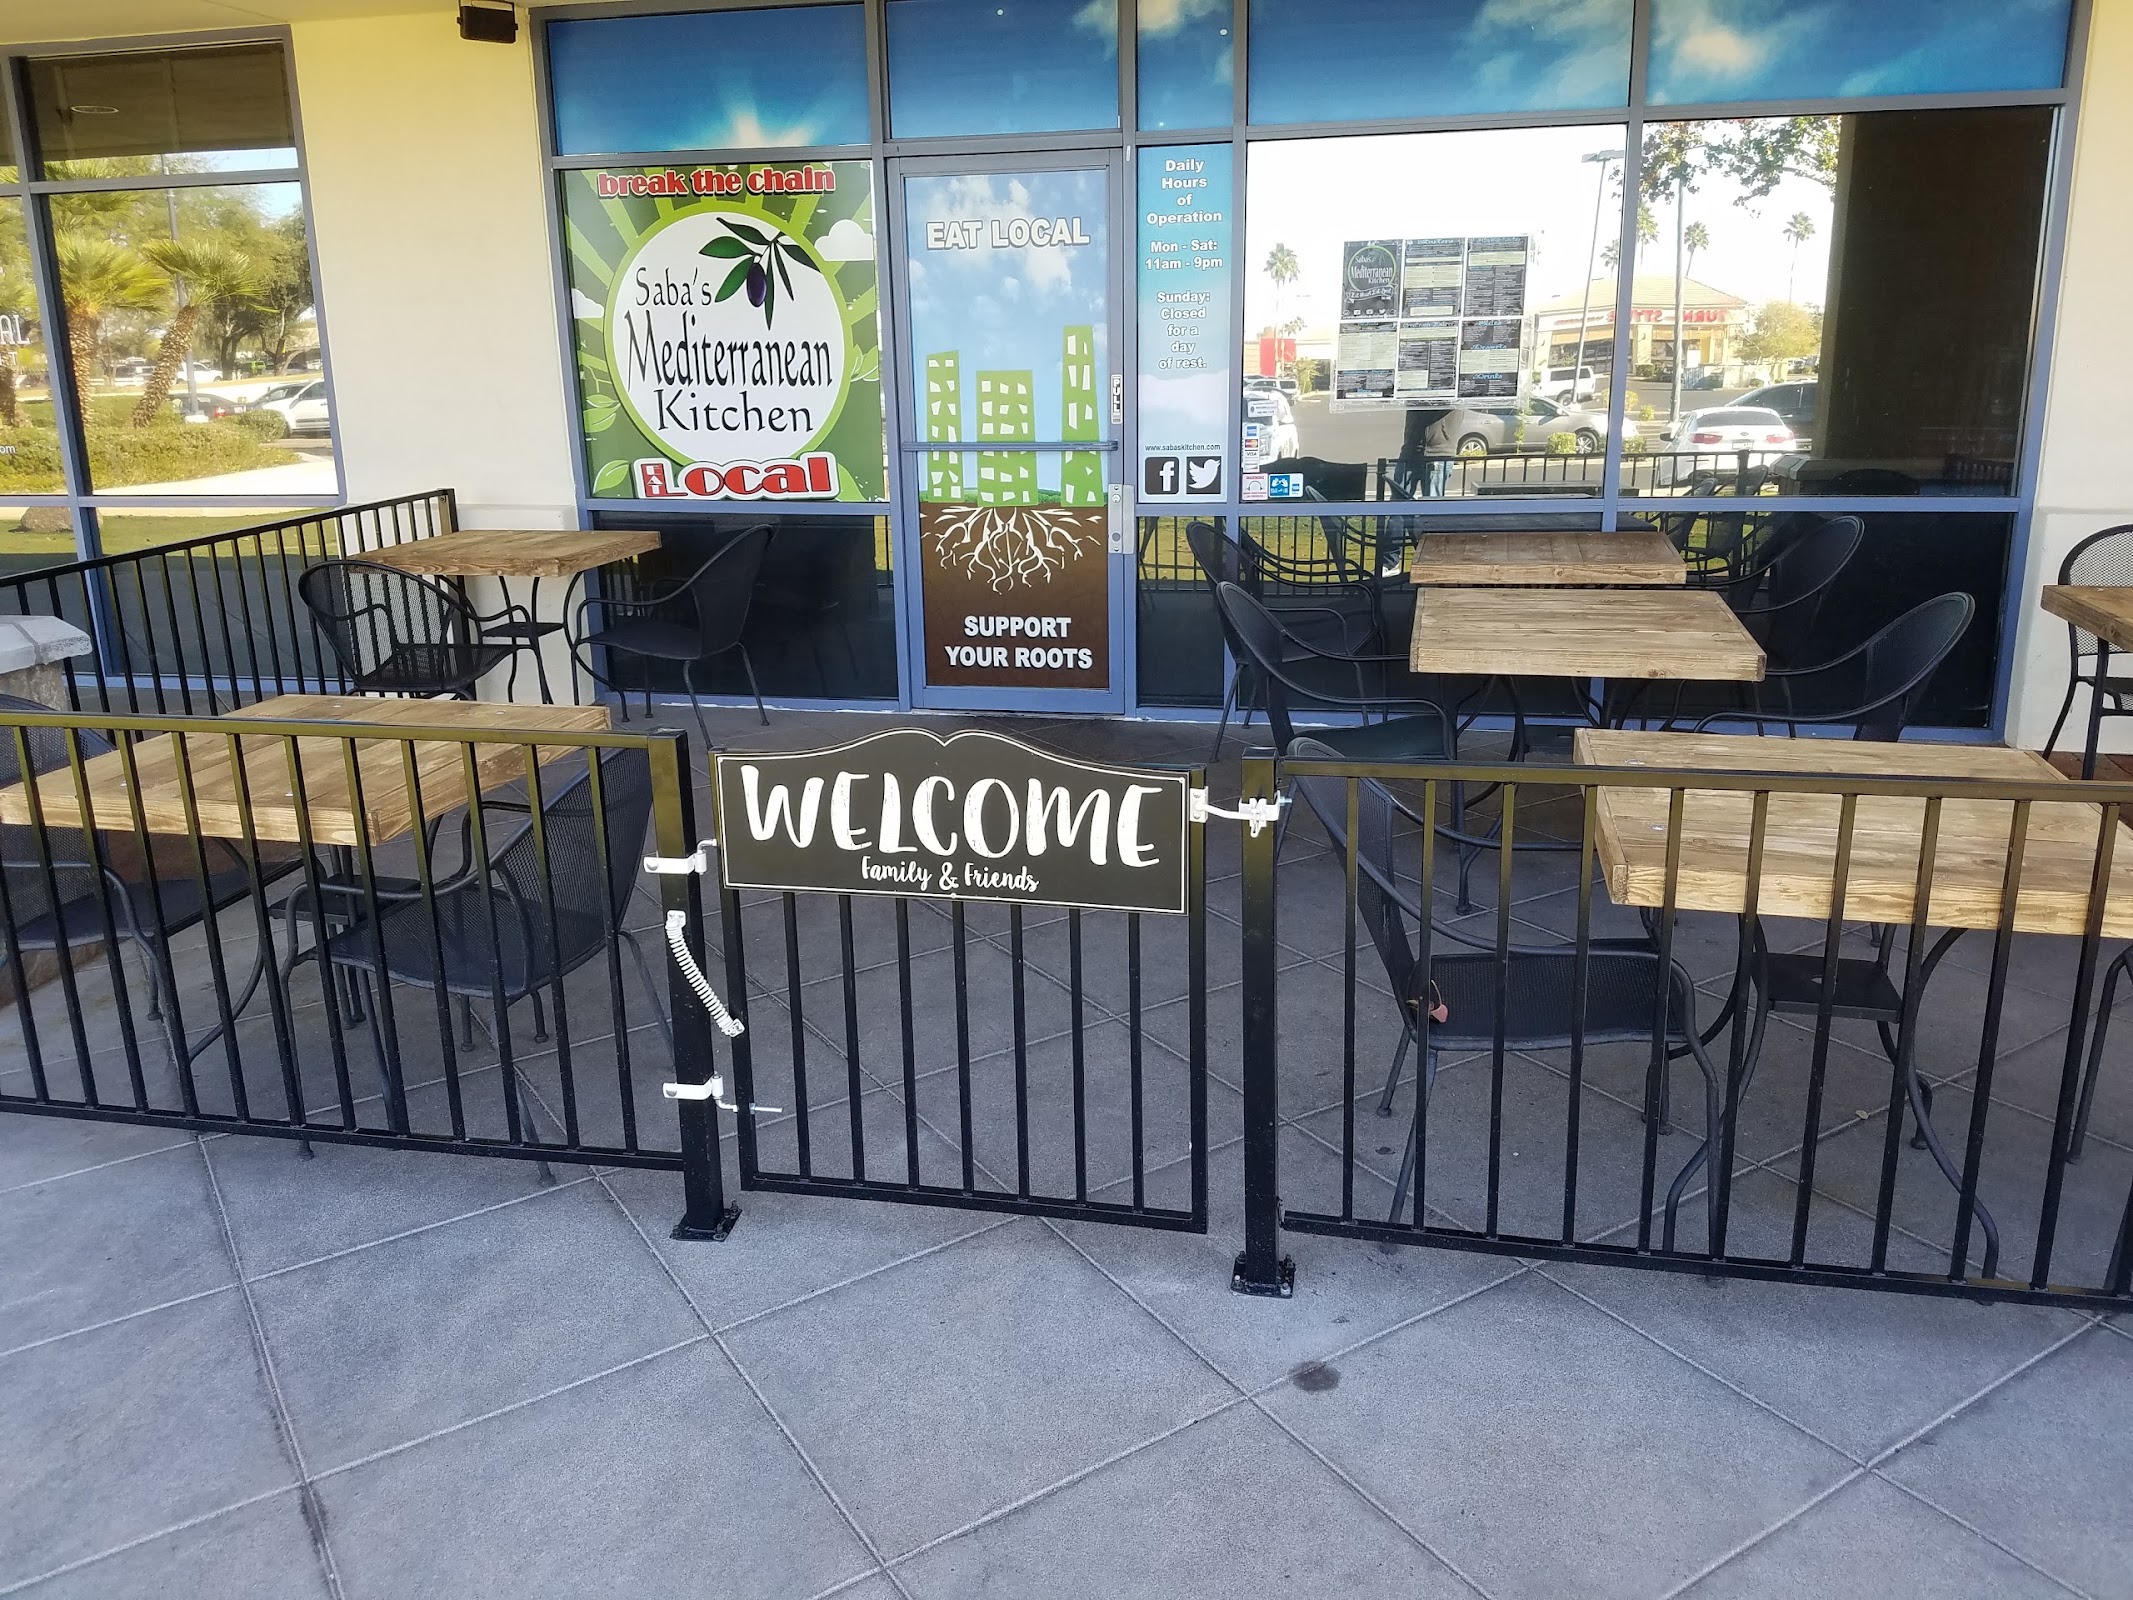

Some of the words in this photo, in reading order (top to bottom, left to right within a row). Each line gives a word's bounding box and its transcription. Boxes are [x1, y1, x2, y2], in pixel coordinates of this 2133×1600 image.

[1165, 159, 1205, 173] Daily
[599, 170, 688, 197] break
[692, 169, 741, 195] the
[747, 166, 836, 192] chain
[1161, 177, 1208, 190] Hours
[1176, 194, 1193, 206] of
[1146, 211, 1222, 227] Operation
[926, 220, 983, 250] EAT
[991, 217, 1091, 248] LOCAL
[1150, 241, 1179, 253] Mon
[1190, 239, 1218, 251] Sat:
[1145, 258, 1182, 270] 11am
[1193, 257, 1224, 271] 9pm
[635, 267, 712, 307] Saba's
[1157, 291, 1210, 305] Sunday:
[1161, 307, 1206, 320] Closed
[1167, 324, 1187, 336] for
[1190, 326, 1199, 335] a
[624, 309, 832, 392] Mediterranean
[1171, 341, 1196, 355] day
[1159, 357, 1173, 369] of
[1176, 357, 1207, 369] rest.
[1112, 378, 1121, 413] PULL
[654, 389, 814, 433] Kitchen
[1144, 443, 1221, 451] www.sabaskitchen.com
[964, 616, 1072, 638] SUPPORT
[945, 646, 1009, 667] YOUR
[1015, 648, 1093, 669] ROOTS
[741, 765, 1163, 868] WELCOME
[861, 856, 932, 891] Family
[938, 861, 960, 890] &
[964, 862, 1040, 892] Friends
